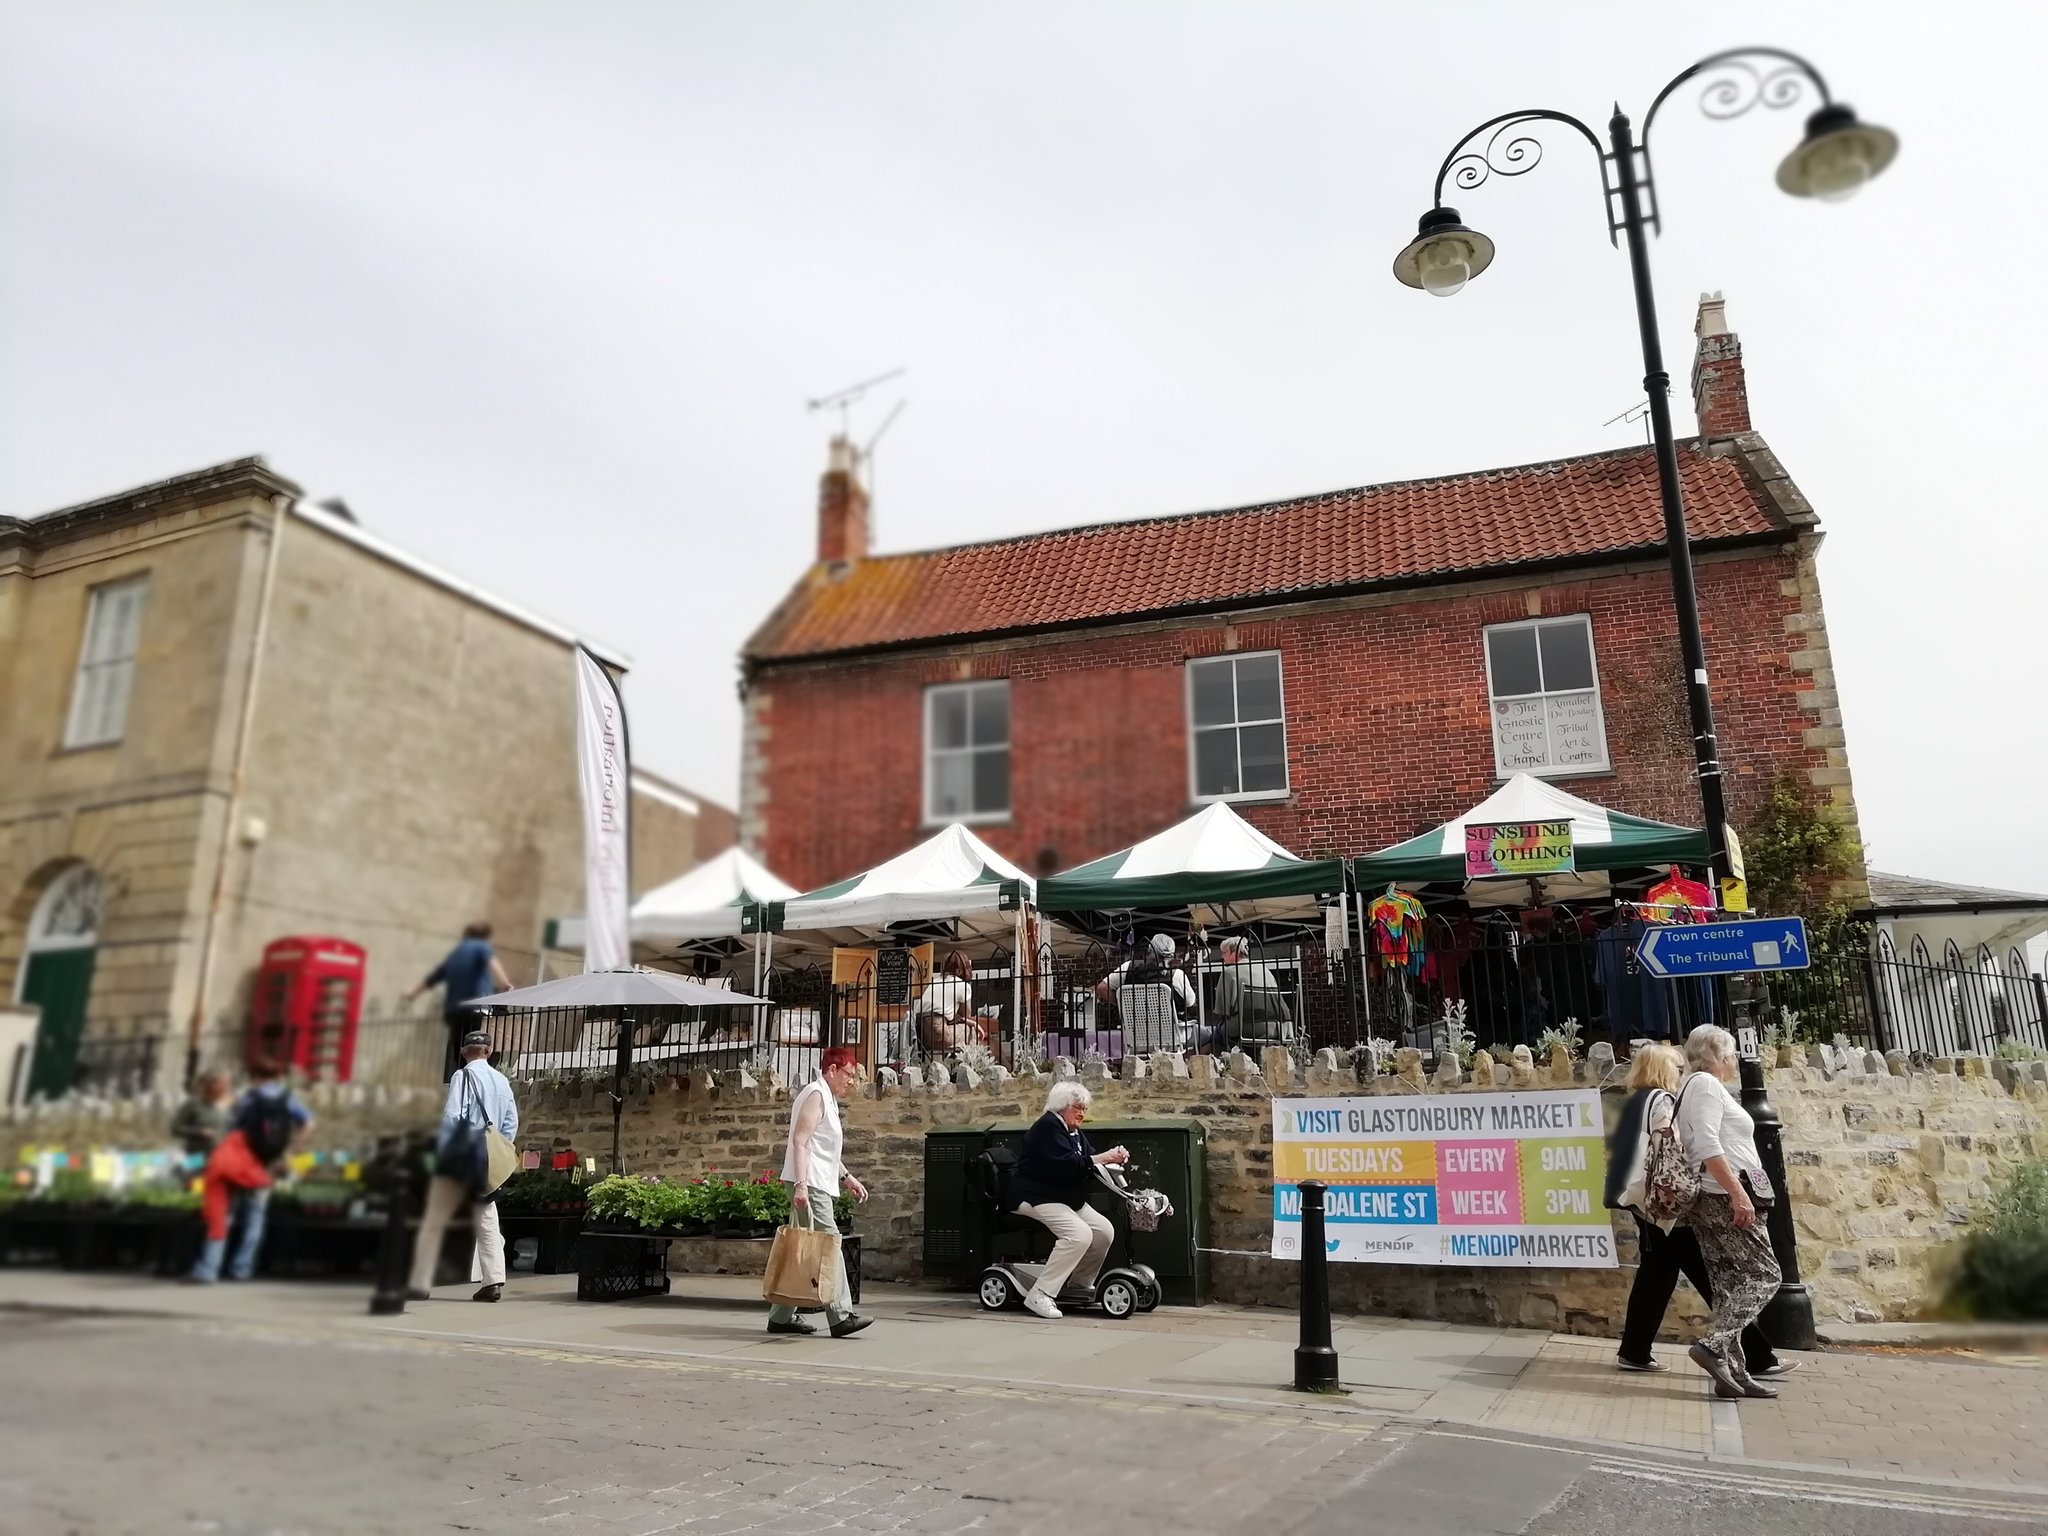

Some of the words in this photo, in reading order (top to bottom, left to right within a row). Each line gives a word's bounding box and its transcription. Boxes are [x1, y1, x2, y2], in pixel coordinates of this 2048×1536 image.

[1512, 701, 1537, 718] The
[1551, 695, 1591, 709] Annabel
[1498, 716, 1544, 731] Gnostic
[1557, 723, 1589, 735] Tribal
[1500, 731, 1543, 744] Centre
[1559, 738, 1578, 748] Art
[1581, 737, 1590, 747] &
[1522, 742, 1533, 754] &
[1503, 752, 1546, 767] Chapel
[1559, 751, 1593, 763] Crafts
[1466, 823, 1569, 841] SUNSHINE
[1467, 845, 1572, 862] CLOTHING
[1665, 931, 1698, 942] Town
[1702, 928, 1744, 940] centre
[1668, 953, 1692, 964] The
[1696, 949, 1749, 963] Tribunal
[1296, 1109, 1342, 1134] VISIT
[1347, 1106, 1485, 1133] GLASTONBURY
[1491, 1103, 1575, 1129] MARKET
[1302, 1147, 1404, 1173] TUESDAYS
[1445, 1147, 1506, 1173] EVERY
[1541, 1146, 1586, 1171] 9AM
[1280, 1191, 1400, 1217] MDALENE
[1403, 1191, 1428, 1218] ST
[1451, 1190, 1509, 1216] WEEK
[1545, 1189, 1591, 1214] 3PM
[1365, 1240, 1414, 1251] MENDIP
[1439, 1234, 1609, 1258] #MENDIPMARKETS
